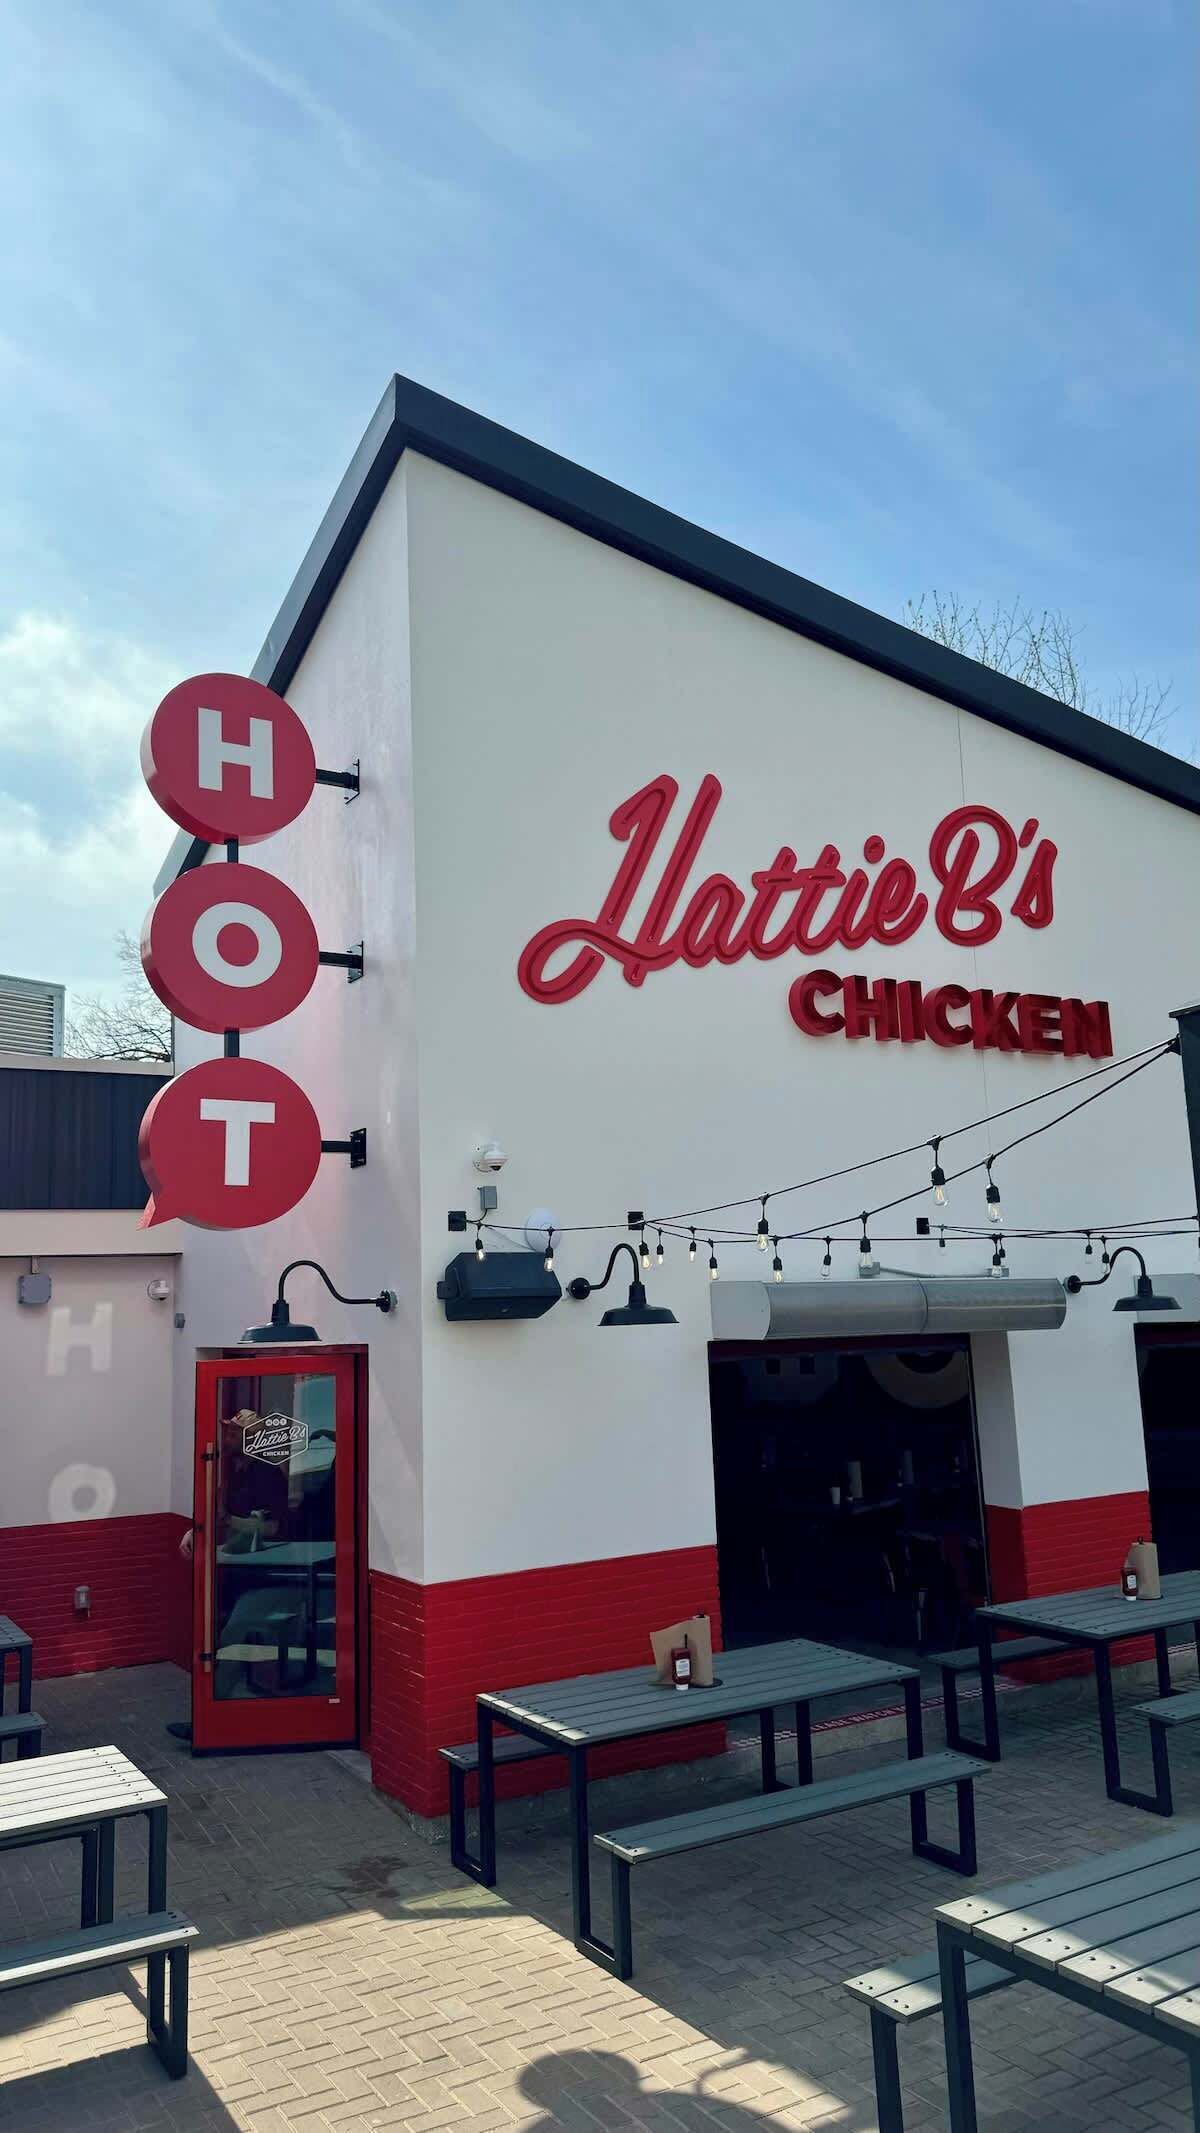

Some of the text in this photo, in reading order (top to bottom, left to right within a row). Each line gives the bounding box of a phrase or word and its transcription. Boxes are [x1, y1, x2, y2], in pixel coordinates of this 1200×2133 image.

[192, 707, 282, 1187] HOT
[517, 773, 1058, 1005] Hattie B's
[788, 968, 1114, 1060] CHICKEN
[246, 1425, 306, 1452] Hattie B's
